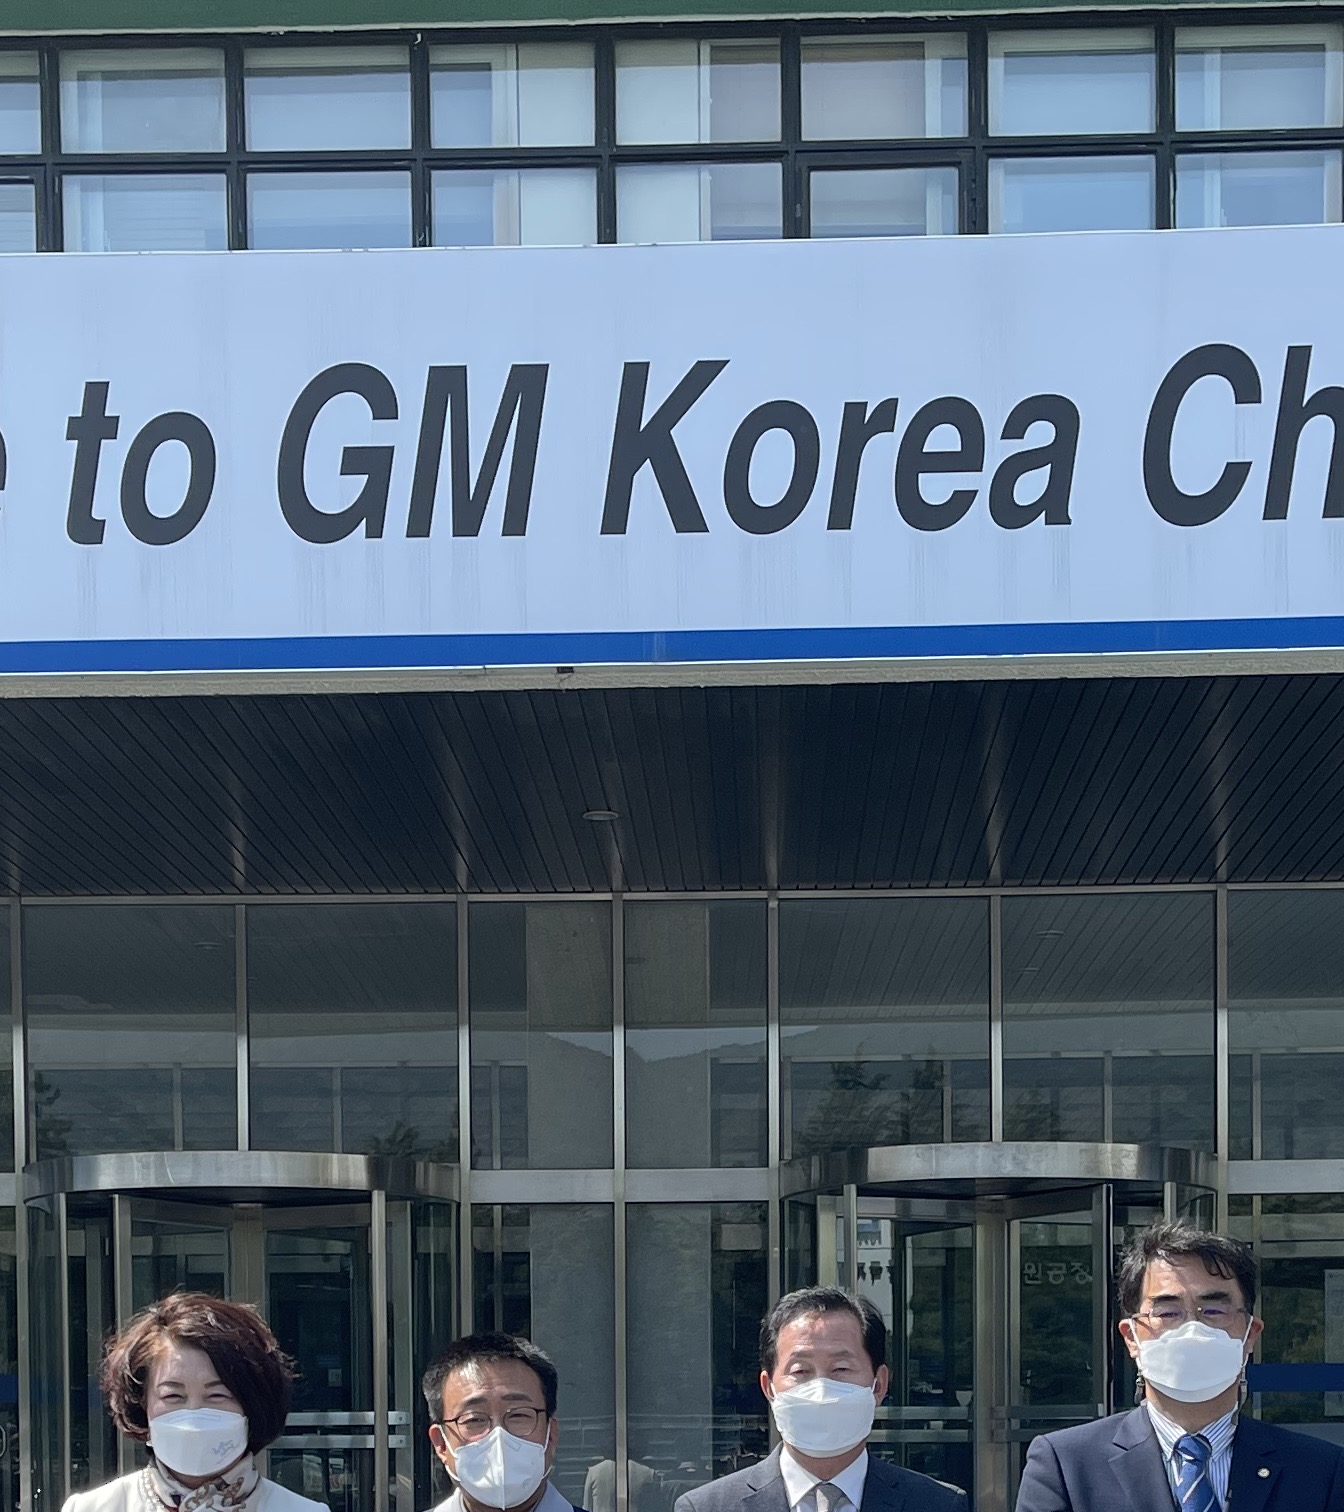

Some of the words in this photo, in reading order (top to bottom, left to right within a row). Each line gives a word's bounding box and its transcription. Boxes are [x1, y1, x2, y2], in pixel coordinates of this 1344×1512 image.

[65, 381, 216, 547] to
[277, 362, 549, 544] GM
[599, 359, 1080, 535] Korea
